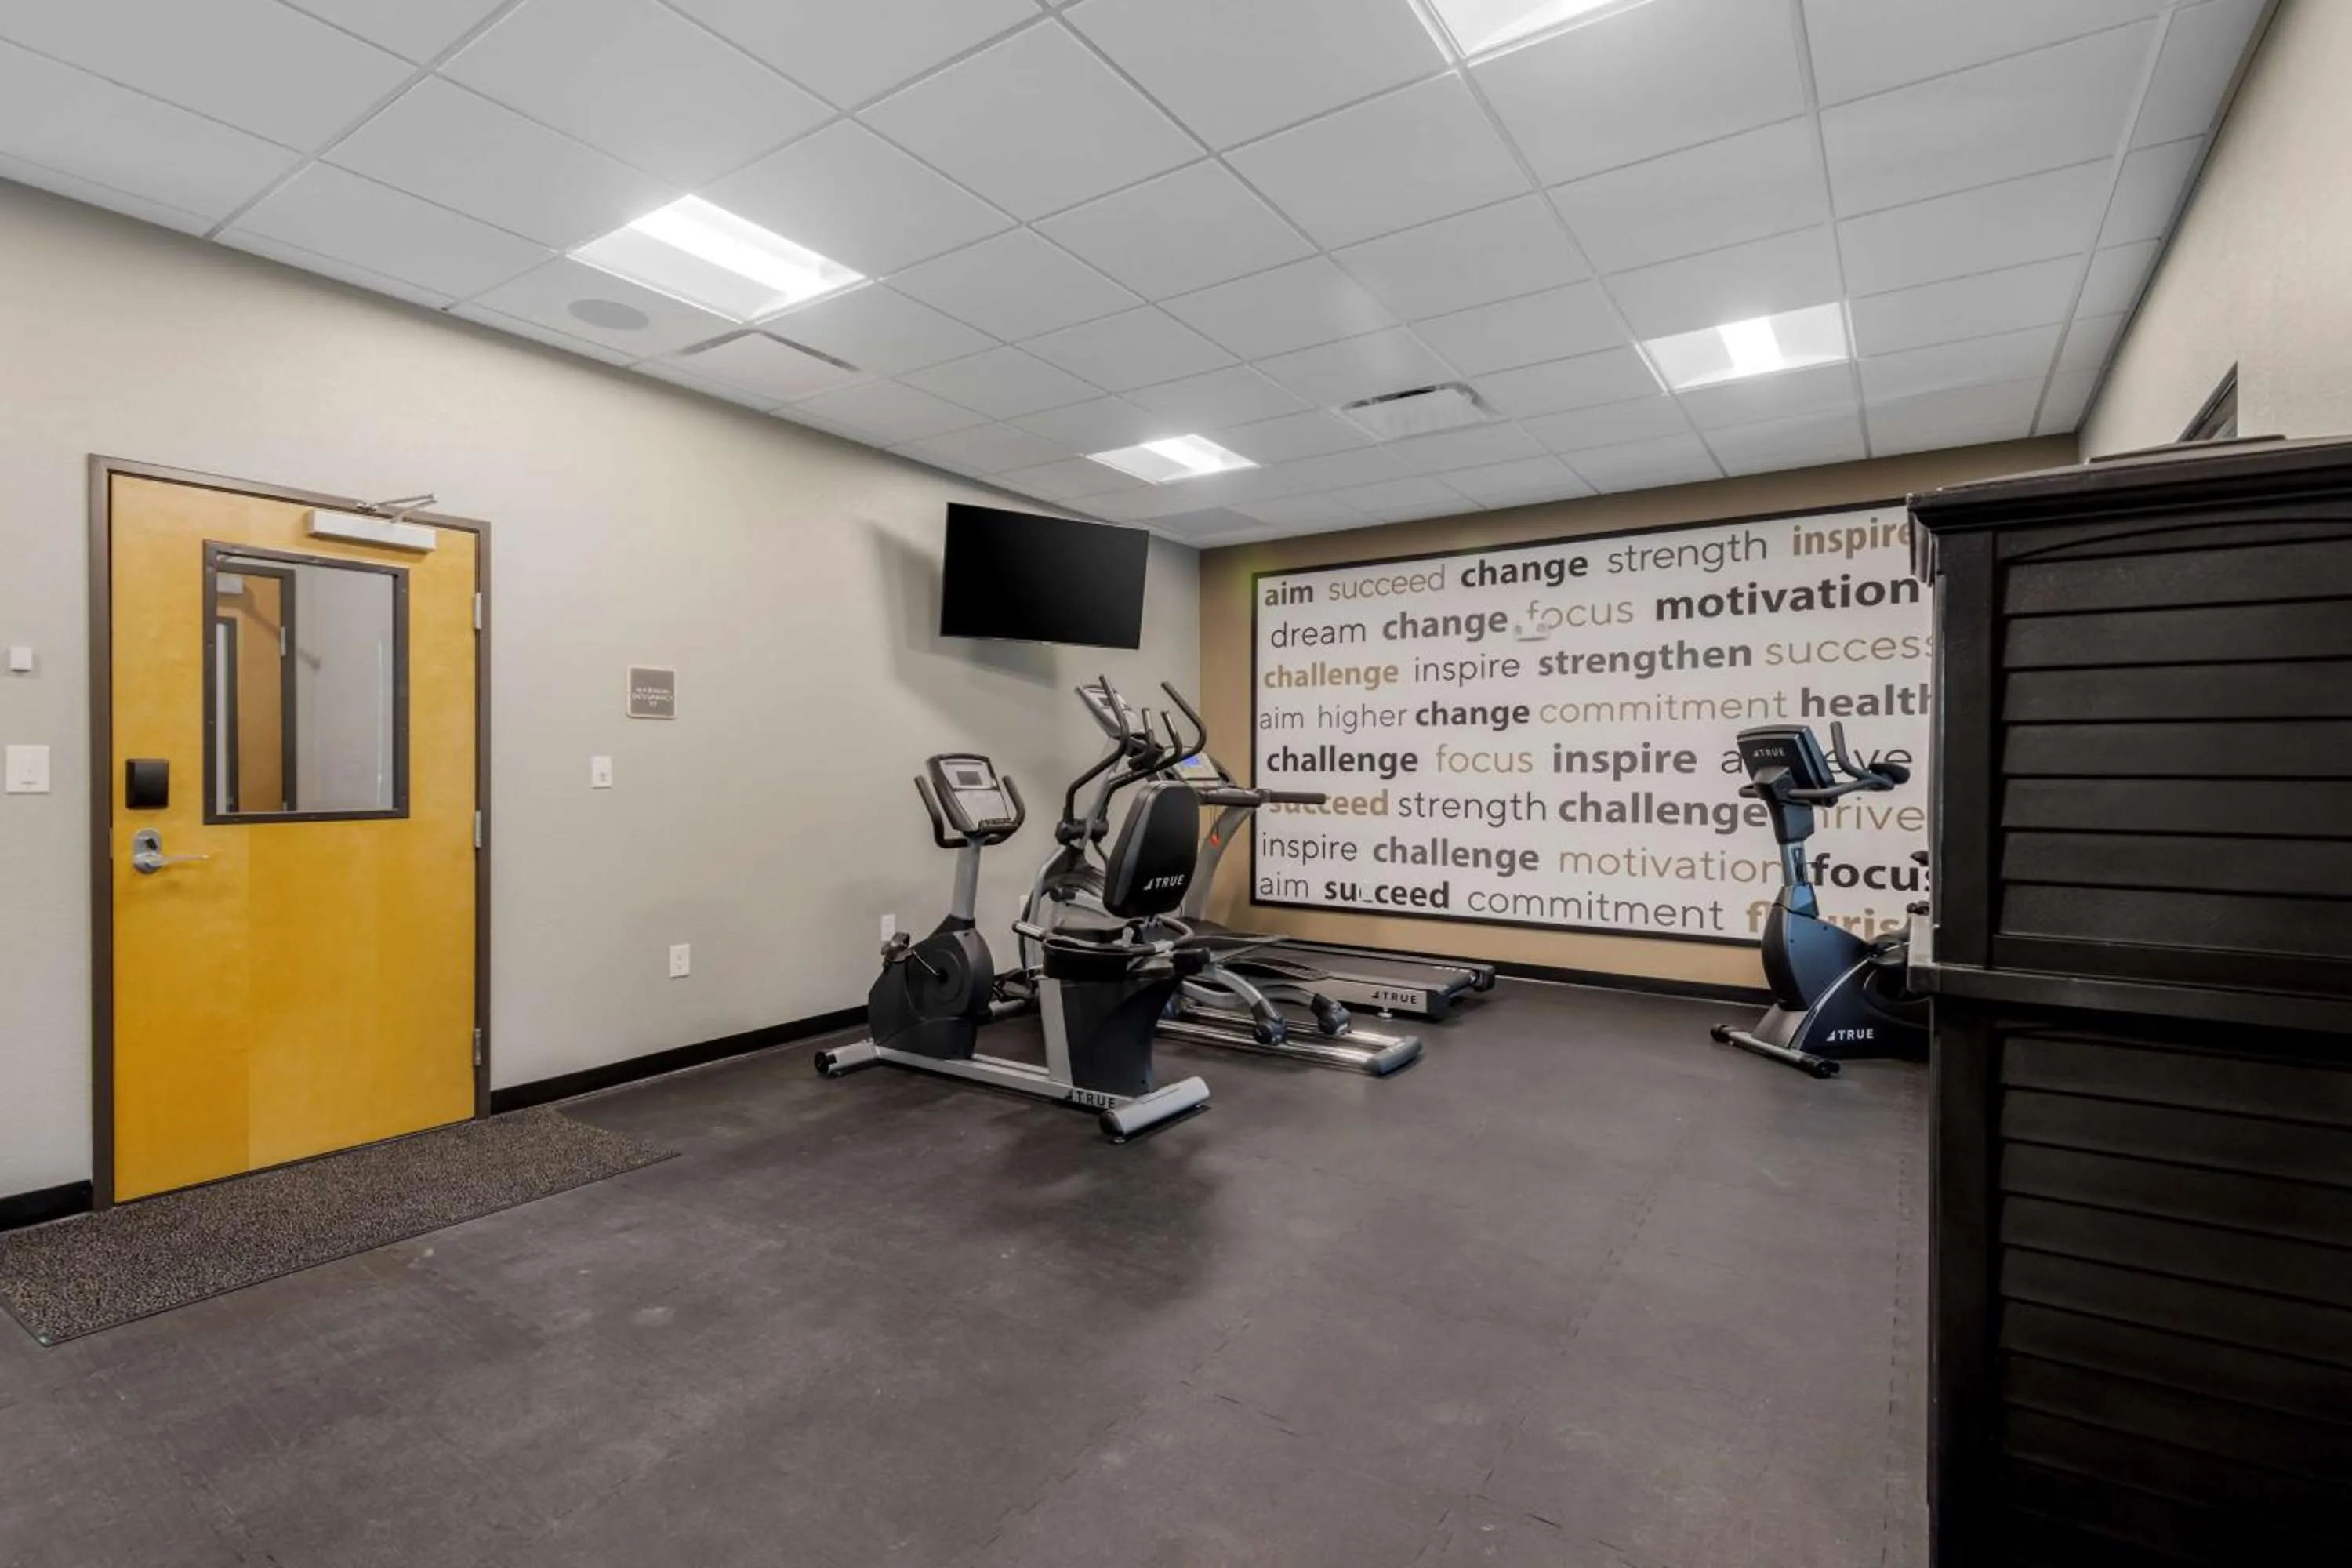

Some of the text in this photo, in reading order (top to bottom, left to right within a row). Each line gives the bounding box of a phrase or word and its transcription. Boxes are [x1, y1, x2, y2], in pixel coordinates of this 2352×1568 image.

[1264, 581, 1314, 607] aim
[1329, 564, 1445, 601] succeed
[1461, 556, 1589, 587] change
[1606, 530, 1767, 574] strength
[1271, 573, 1920, 648] dream change focus motivation
[1263, 662, 1400, 691] challenge
[1415, 653, 1520, 688] inspire
[1537, 639, 1752, 680] strengthen
[1259, 706, 1304, 730] aim
[1318, 704, 1408, 735] higher
[1415, 700, 1530, 731] change
[1540, 690, 1788, 724] commitment
[1266, 745, 1418, 780] challenge
[1436, 743, 1534, 774] focus
[1553, 742, 1697, 782] inspire
[1398, 791, 1547, 828] strength
[1559, 791, 1768, 835] challenge
[1822, 796, 1926, 832] rive
[1155, 873, 1185, 890] TRUE
[1262, 832, 1358, 866] inspire
[1373, 835, 1540, 877] challenge
[1809, 852, 1929, 892] focu
[1259, 871, 1309, 898] aim
[1324, 880, 1450, 909] suceed
[1467, 891, 1724, 931] commitment
[1383, 992, 1417, 1004] TRUE
[1837, 1028, 1875, 1040] TRUE
[1076, 1091, 1116, 1109] TRUE
